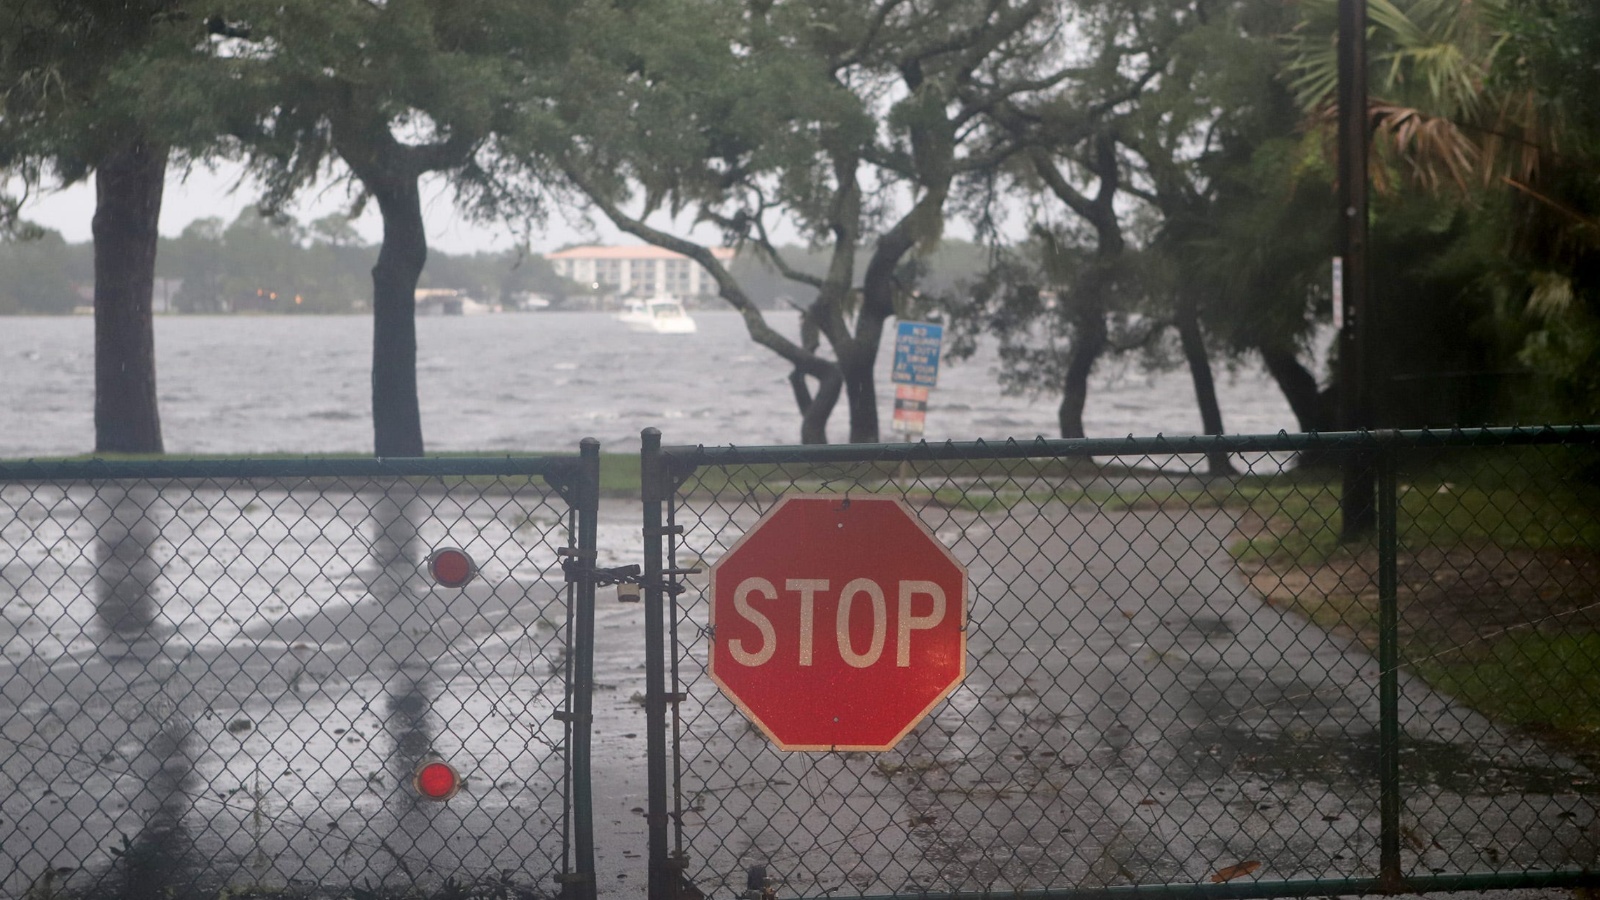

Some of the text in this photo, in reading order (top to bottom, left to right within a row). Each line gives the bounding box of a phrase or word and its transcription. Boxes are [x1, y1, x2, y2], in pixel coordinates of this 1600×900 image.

[914, 328, 927, 336] NO
[915, 346, 938, 355] DUTY
[728, 577, 946, 668] STOP
